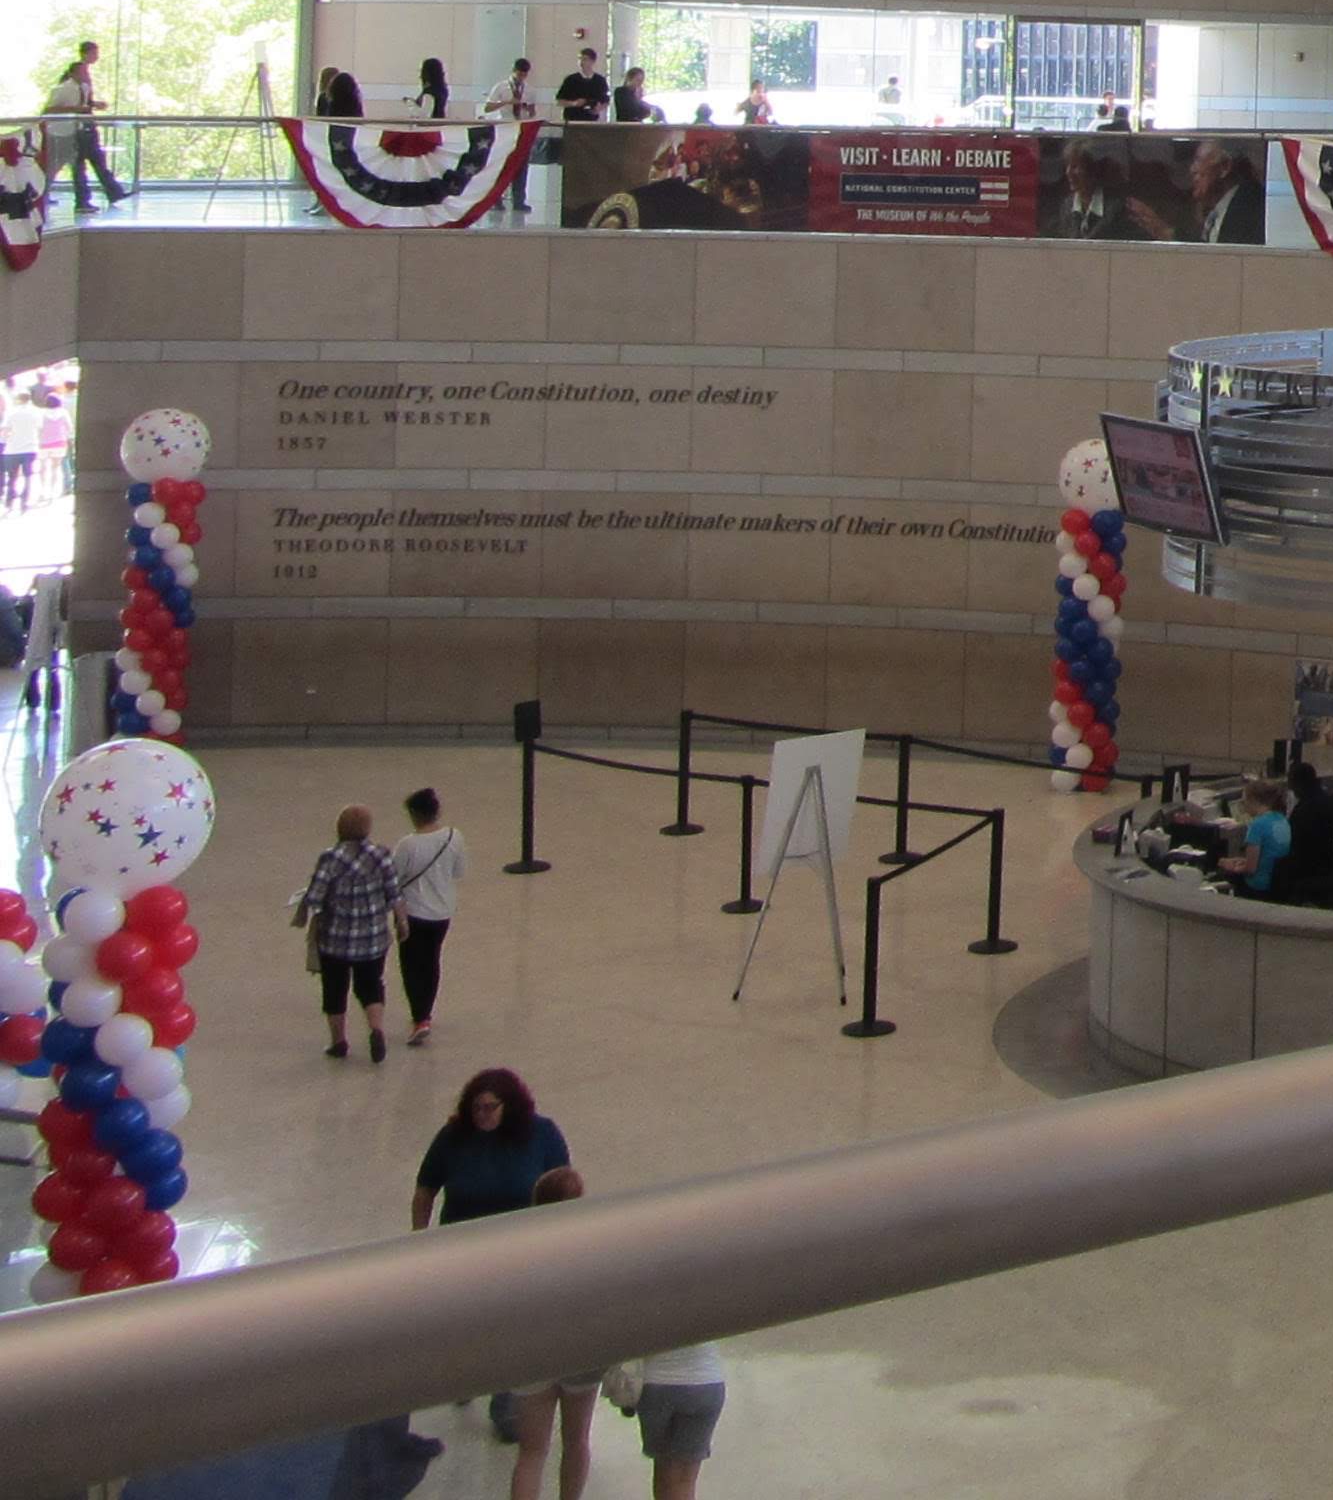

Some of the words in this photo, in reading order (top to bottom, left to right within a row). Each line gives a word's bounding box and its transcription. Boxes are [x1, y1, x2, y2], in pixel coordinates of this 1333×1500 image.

[840, 147, 879, 165] VISIT
[892, 148, 941, 167] LEARN
[955, 150, 1011, 168] DEBATE
[845, 184, 884, 193] NATIONAL
[886, 185, 944, 194] CONSTITUTION
[945, 186, 976, 195] CENTER
[857, 209, 873, 220] THE
[876, 210, 914, 221] MUSEUM
[916, 211, 928, 221] OF
[962, 211, 991, 227] People
[278, 380, 329, 400] One
[334, 383, 434, 404] country,
[443, 385, 486, 400] one
[490, 380, 641, 406] Constitution,
[649, 388, 691, 403] one
[697, 385, 778, 410] destiny
[280, 411, 371, 425] DANIEL
[384, 410, 491, 425] WEBSTER
[274, 508, 317, 528] The
[318, 509, 394, 531] people
[398, 508, 516, 528] themselves
[519, 511, 572, 528] must
[577, 510, 604, 528] be
[606, 510, 642, 530] the
[644, 511, 736, 531] ultimate
[738, 514, 816, 533] makers
[819, 514, 845, 533] of
[846, 516, 896, 537] their
[901, 521, 944, 538] own
[949, 518, 1057, 544] Constitutio
[274, 538, 394, 553] THEODORE
[405, 538, 528, 554] ROOSEVELT
[273, 565, 318, 579] 1912
